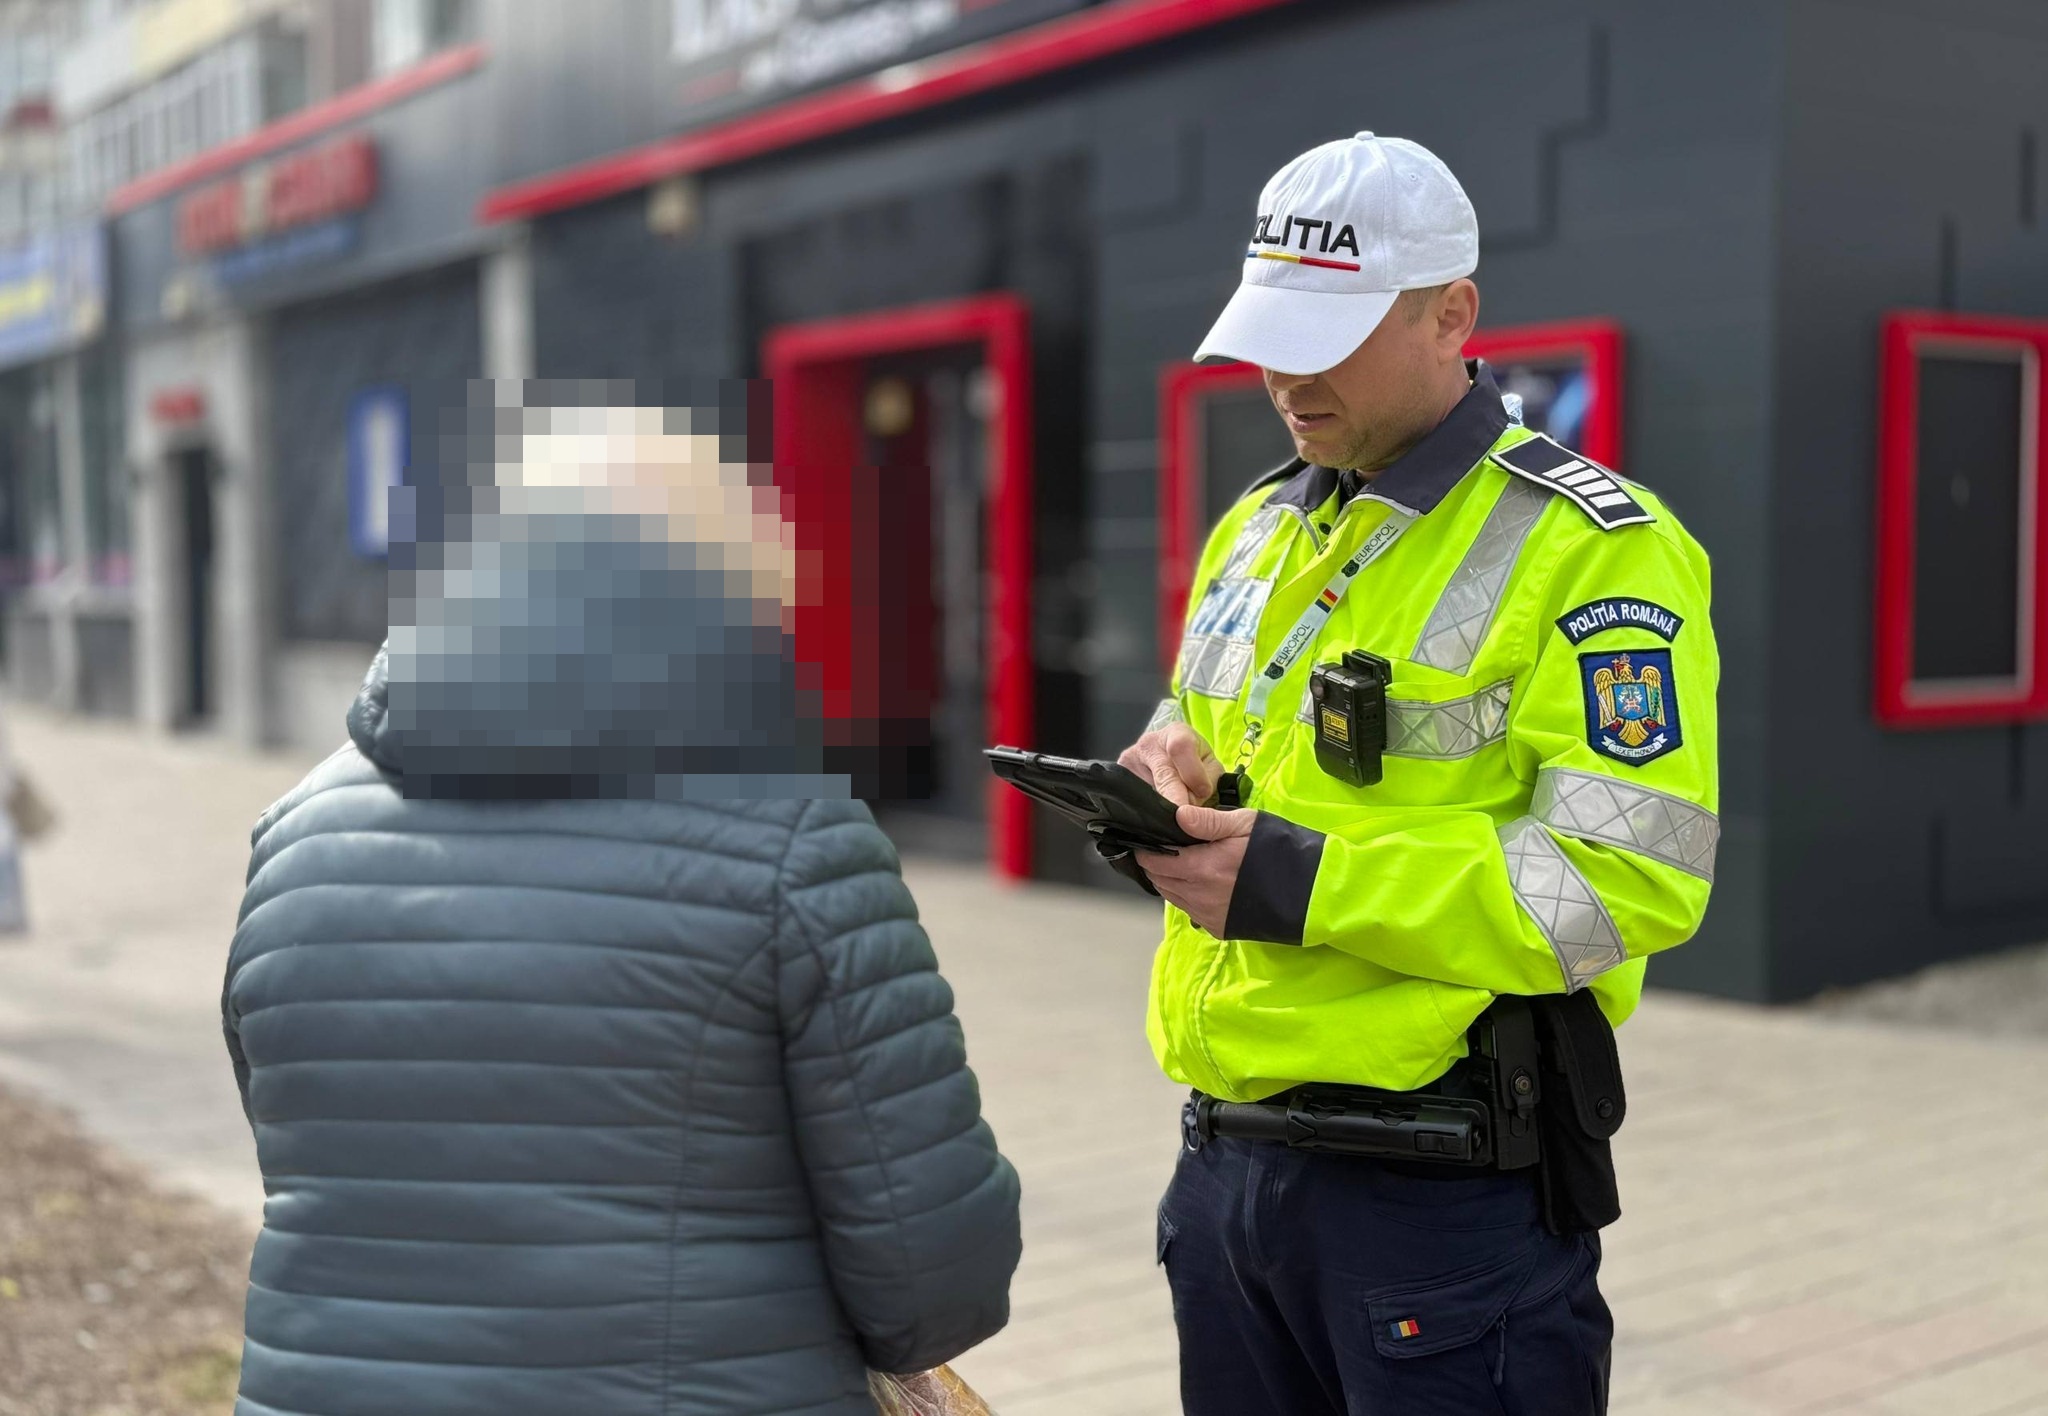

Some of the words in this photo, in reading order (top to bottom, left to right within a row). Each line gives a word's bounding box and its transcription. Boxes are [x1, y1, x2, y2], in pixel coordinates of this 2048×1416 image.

[1252, 214, 1359, 256] OLITIA
[1355, 523, 1395, 562] EUROPOL
[1275, 623, 1310, 665] EUROPOL
